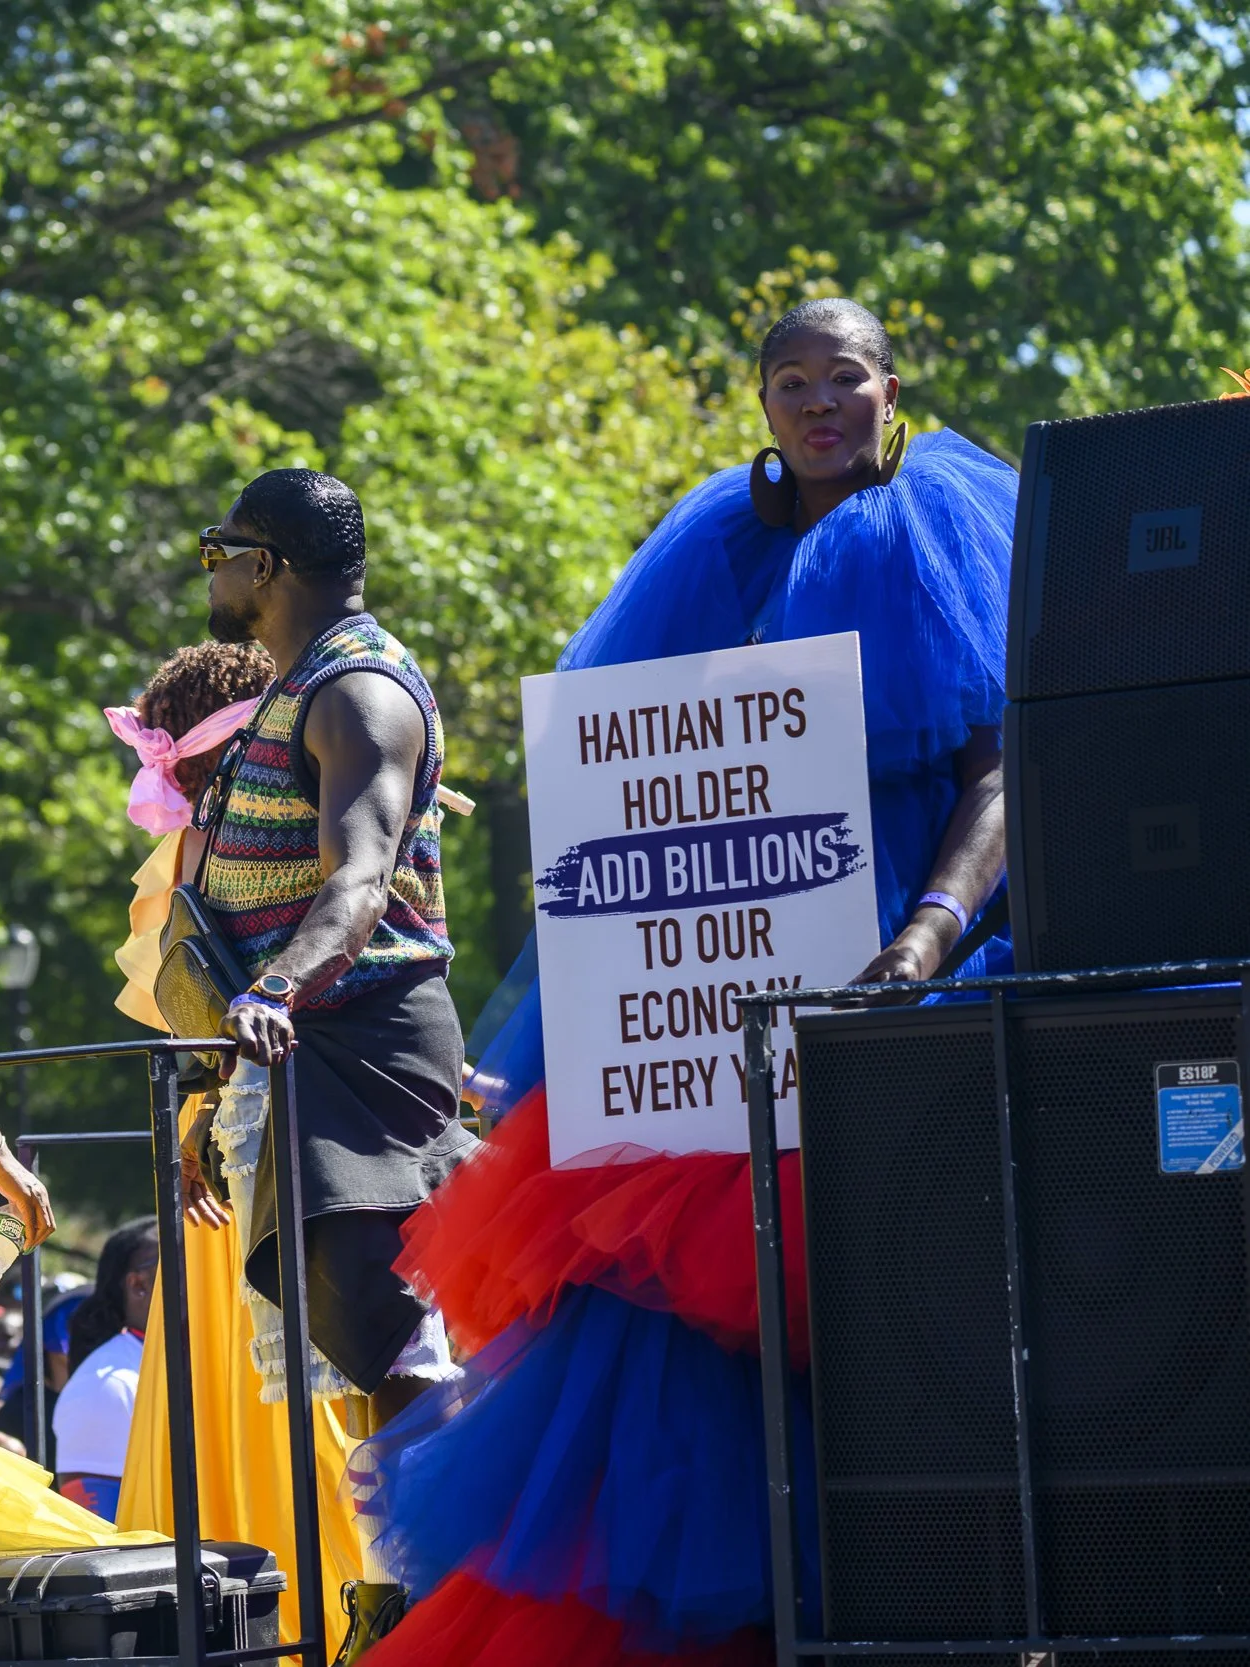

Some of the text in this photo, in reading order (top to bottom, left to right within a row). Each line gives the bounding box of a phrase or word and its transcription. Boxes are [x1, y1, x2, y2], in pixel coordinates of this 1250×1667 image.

[1146, 525, 1187, 553] JBL
[578, 687, 807, 765] HAITIAN TPS
[623, 764, 772, 830] HOLDER
[577, 826, 840, 907] ADD BILLIONS
[637, 907, 775, 971] TO OUR
[602, 1055, 719, 1117] EVERY
[1208, 1131, 1240, 1169] POWERED
[0, 1218, 24, 1231] Poland
